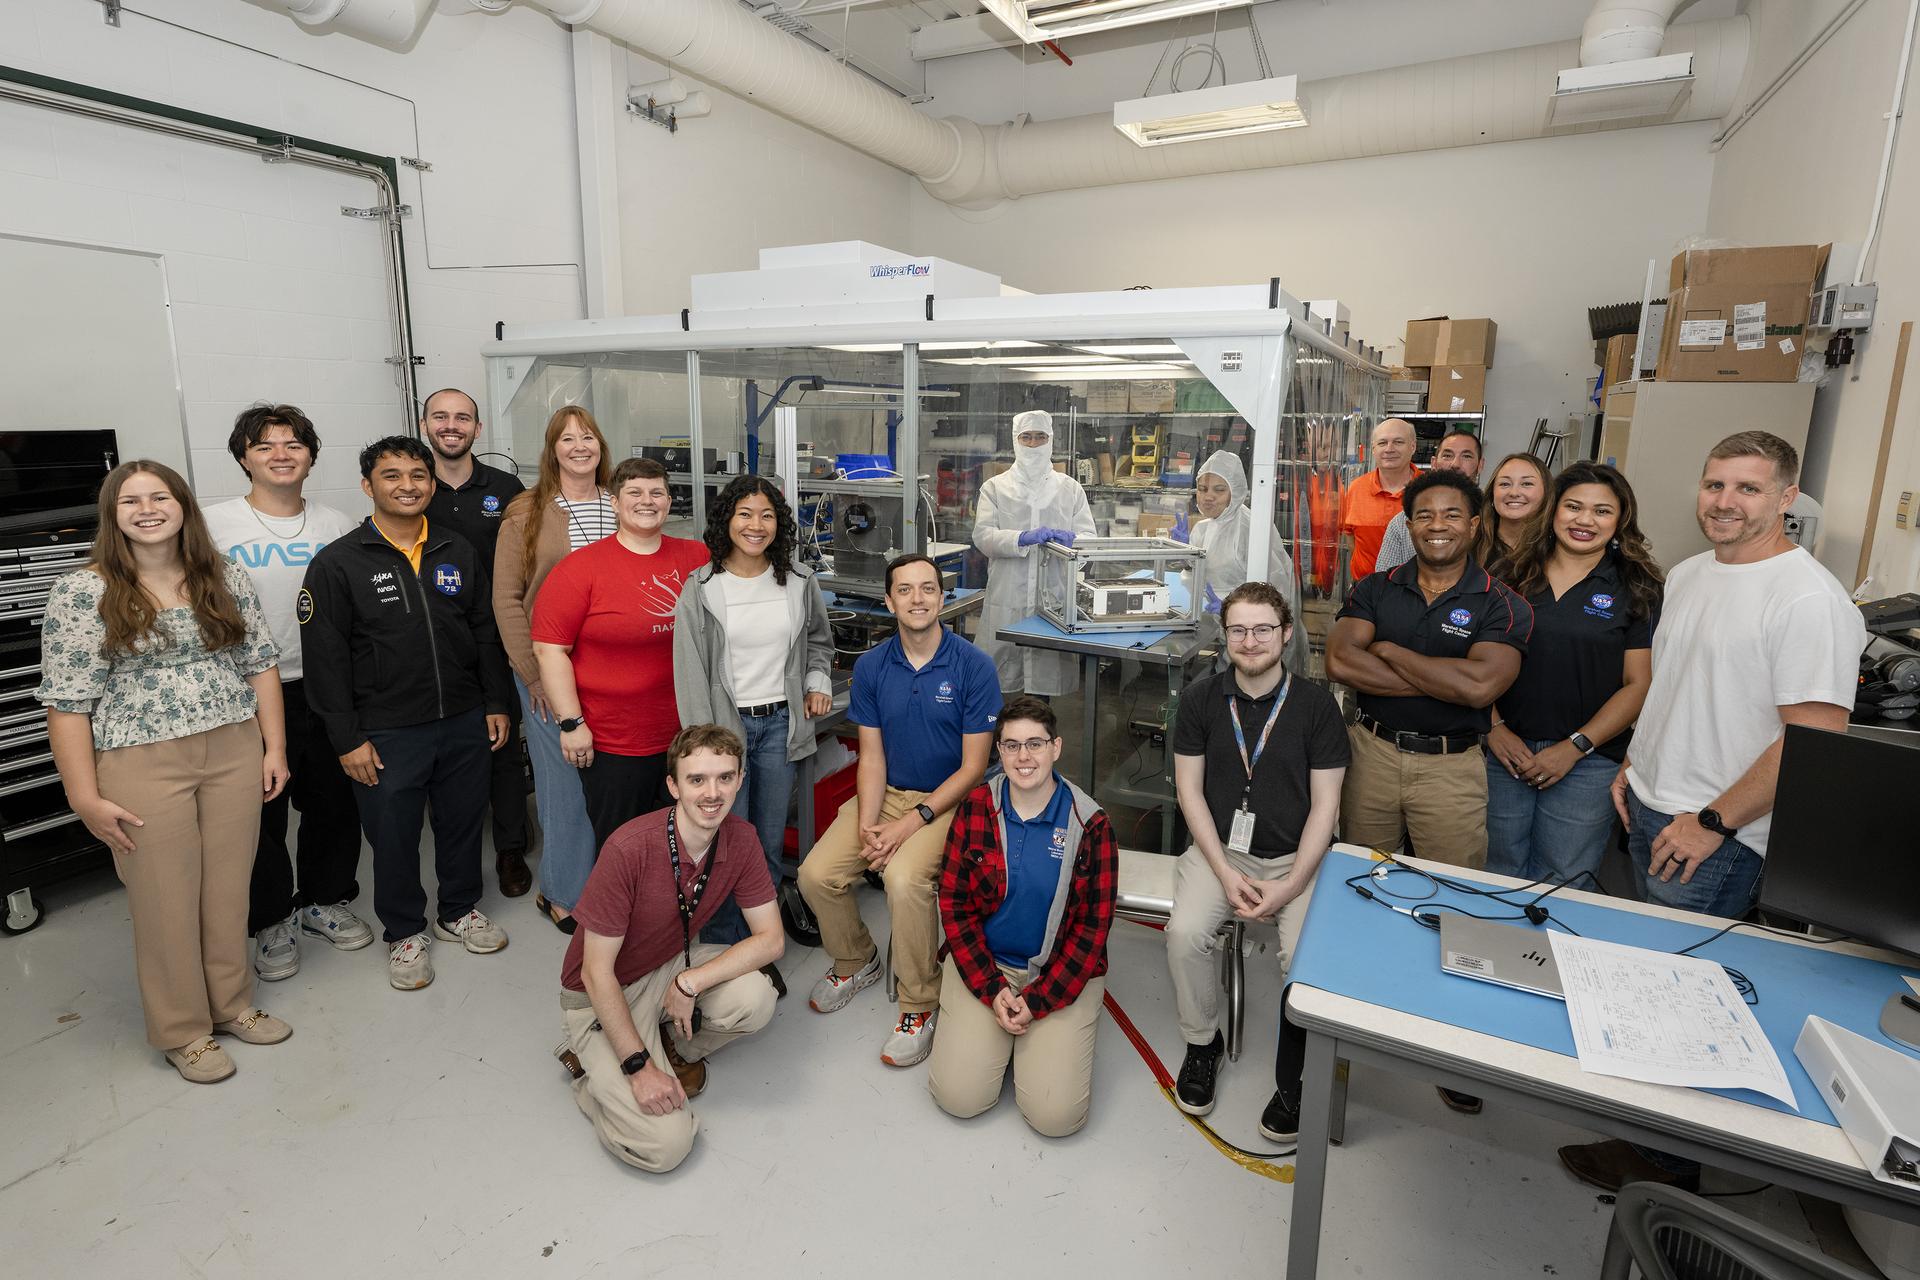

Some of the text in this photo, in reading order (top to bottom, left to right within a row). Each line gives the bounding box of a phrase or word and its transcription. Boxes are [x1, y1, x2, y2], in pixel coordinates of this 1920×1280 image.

[870, 264, 931, 279] WhisperFlow
[229, 543, 327, 568] NAS
[371, 572, 393, 585] JAXA
[377, 584, 397, 593] NASA
[669, 834, 677, 853] NASA
